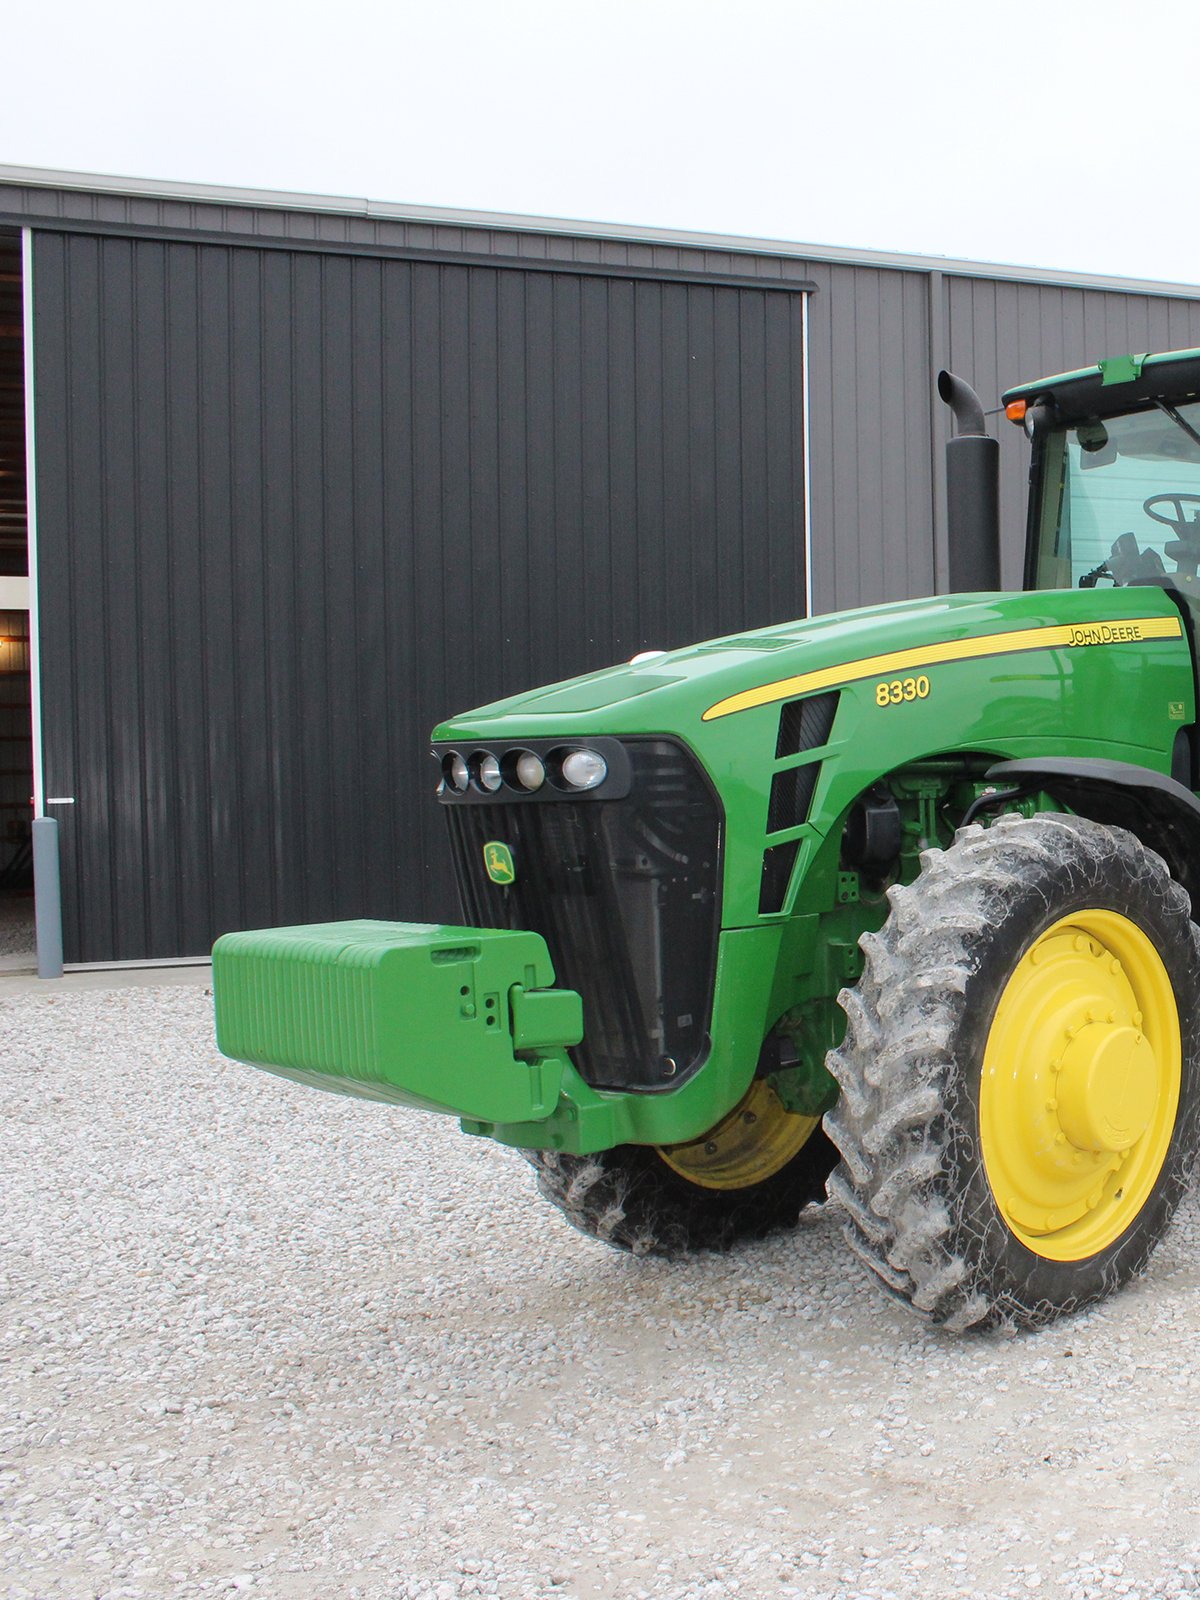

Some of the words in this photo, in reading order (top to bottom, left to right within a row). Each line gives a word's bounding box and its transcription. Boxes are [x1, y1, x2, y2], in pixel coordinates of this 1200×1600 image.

[1069, 628, 1102, 645] JOHN
[1101, 626, 1142, 642] DEERE
[876, 675, 930, 707] 8330
